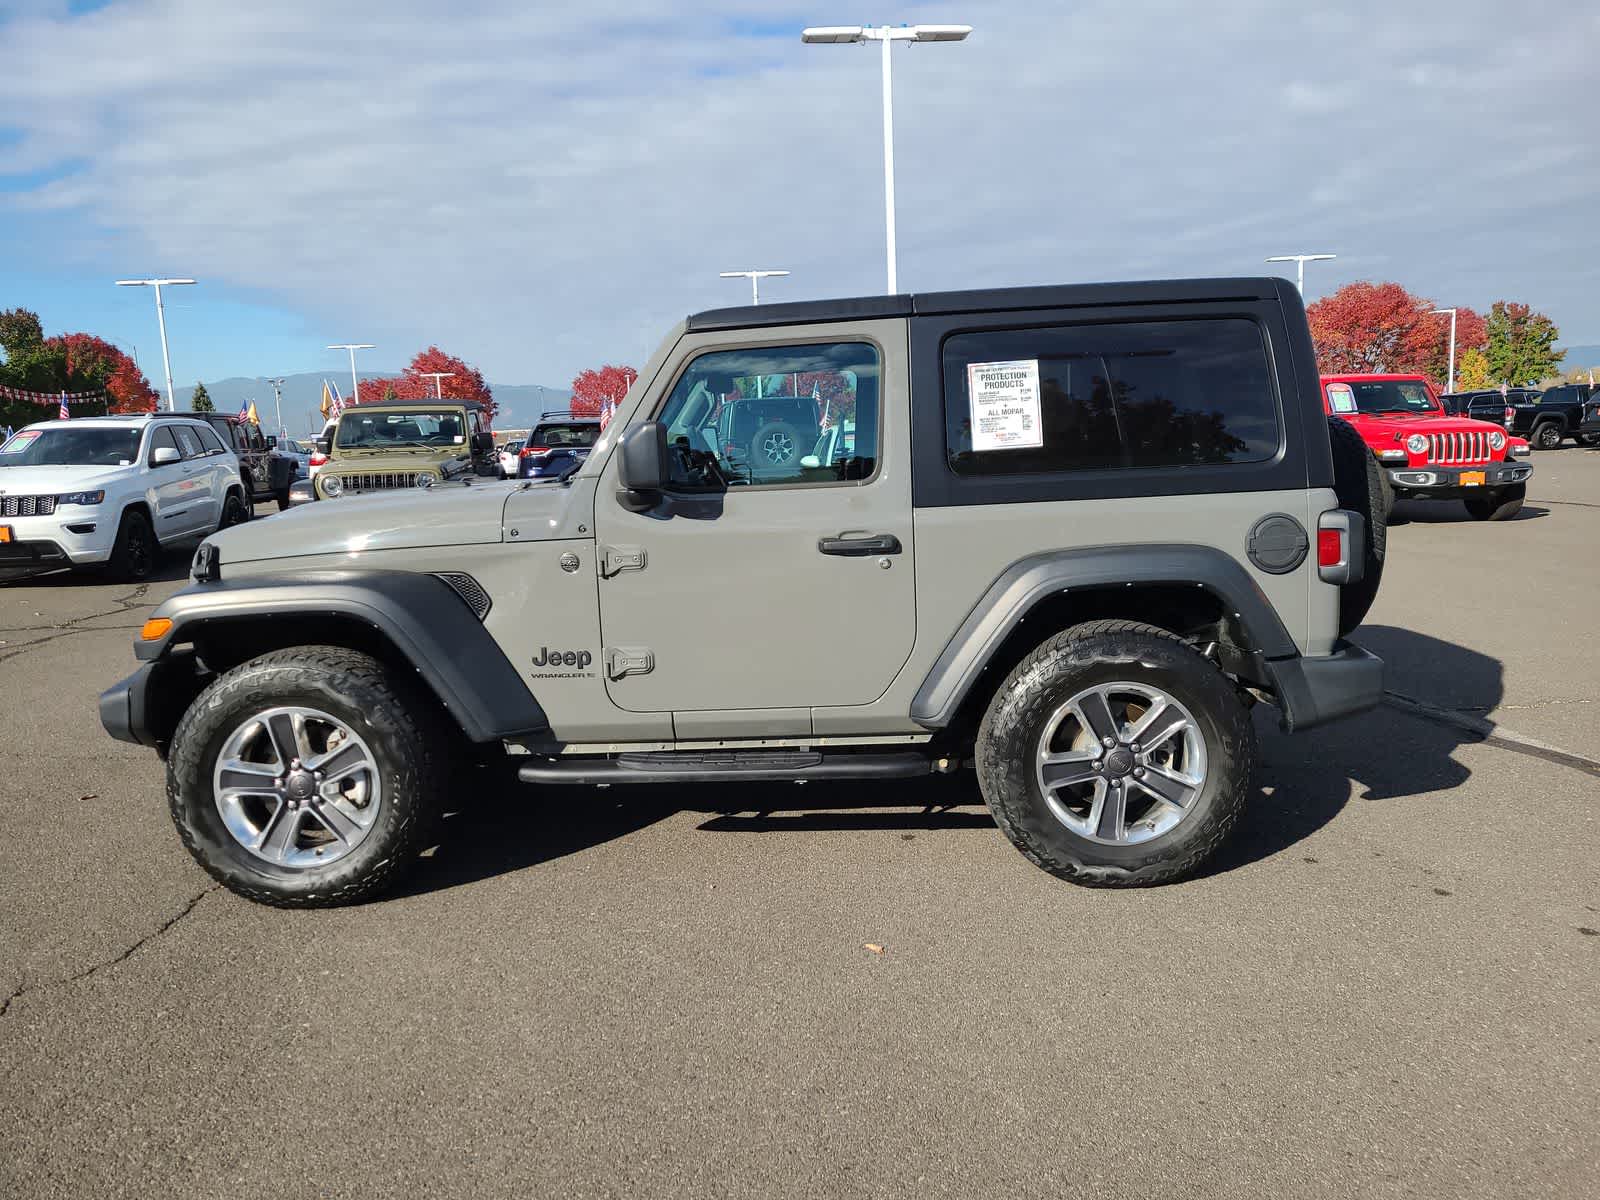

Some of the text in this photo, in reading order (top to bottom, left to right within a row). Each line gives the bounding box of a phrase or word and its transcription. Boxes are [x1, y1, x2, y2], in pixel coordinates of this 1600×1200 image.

[980, 371, 1027, 382] PROTECTION
[984, 380, 1024, 389] PRODUCTS
[532, 647, 592, 669] Jeep
